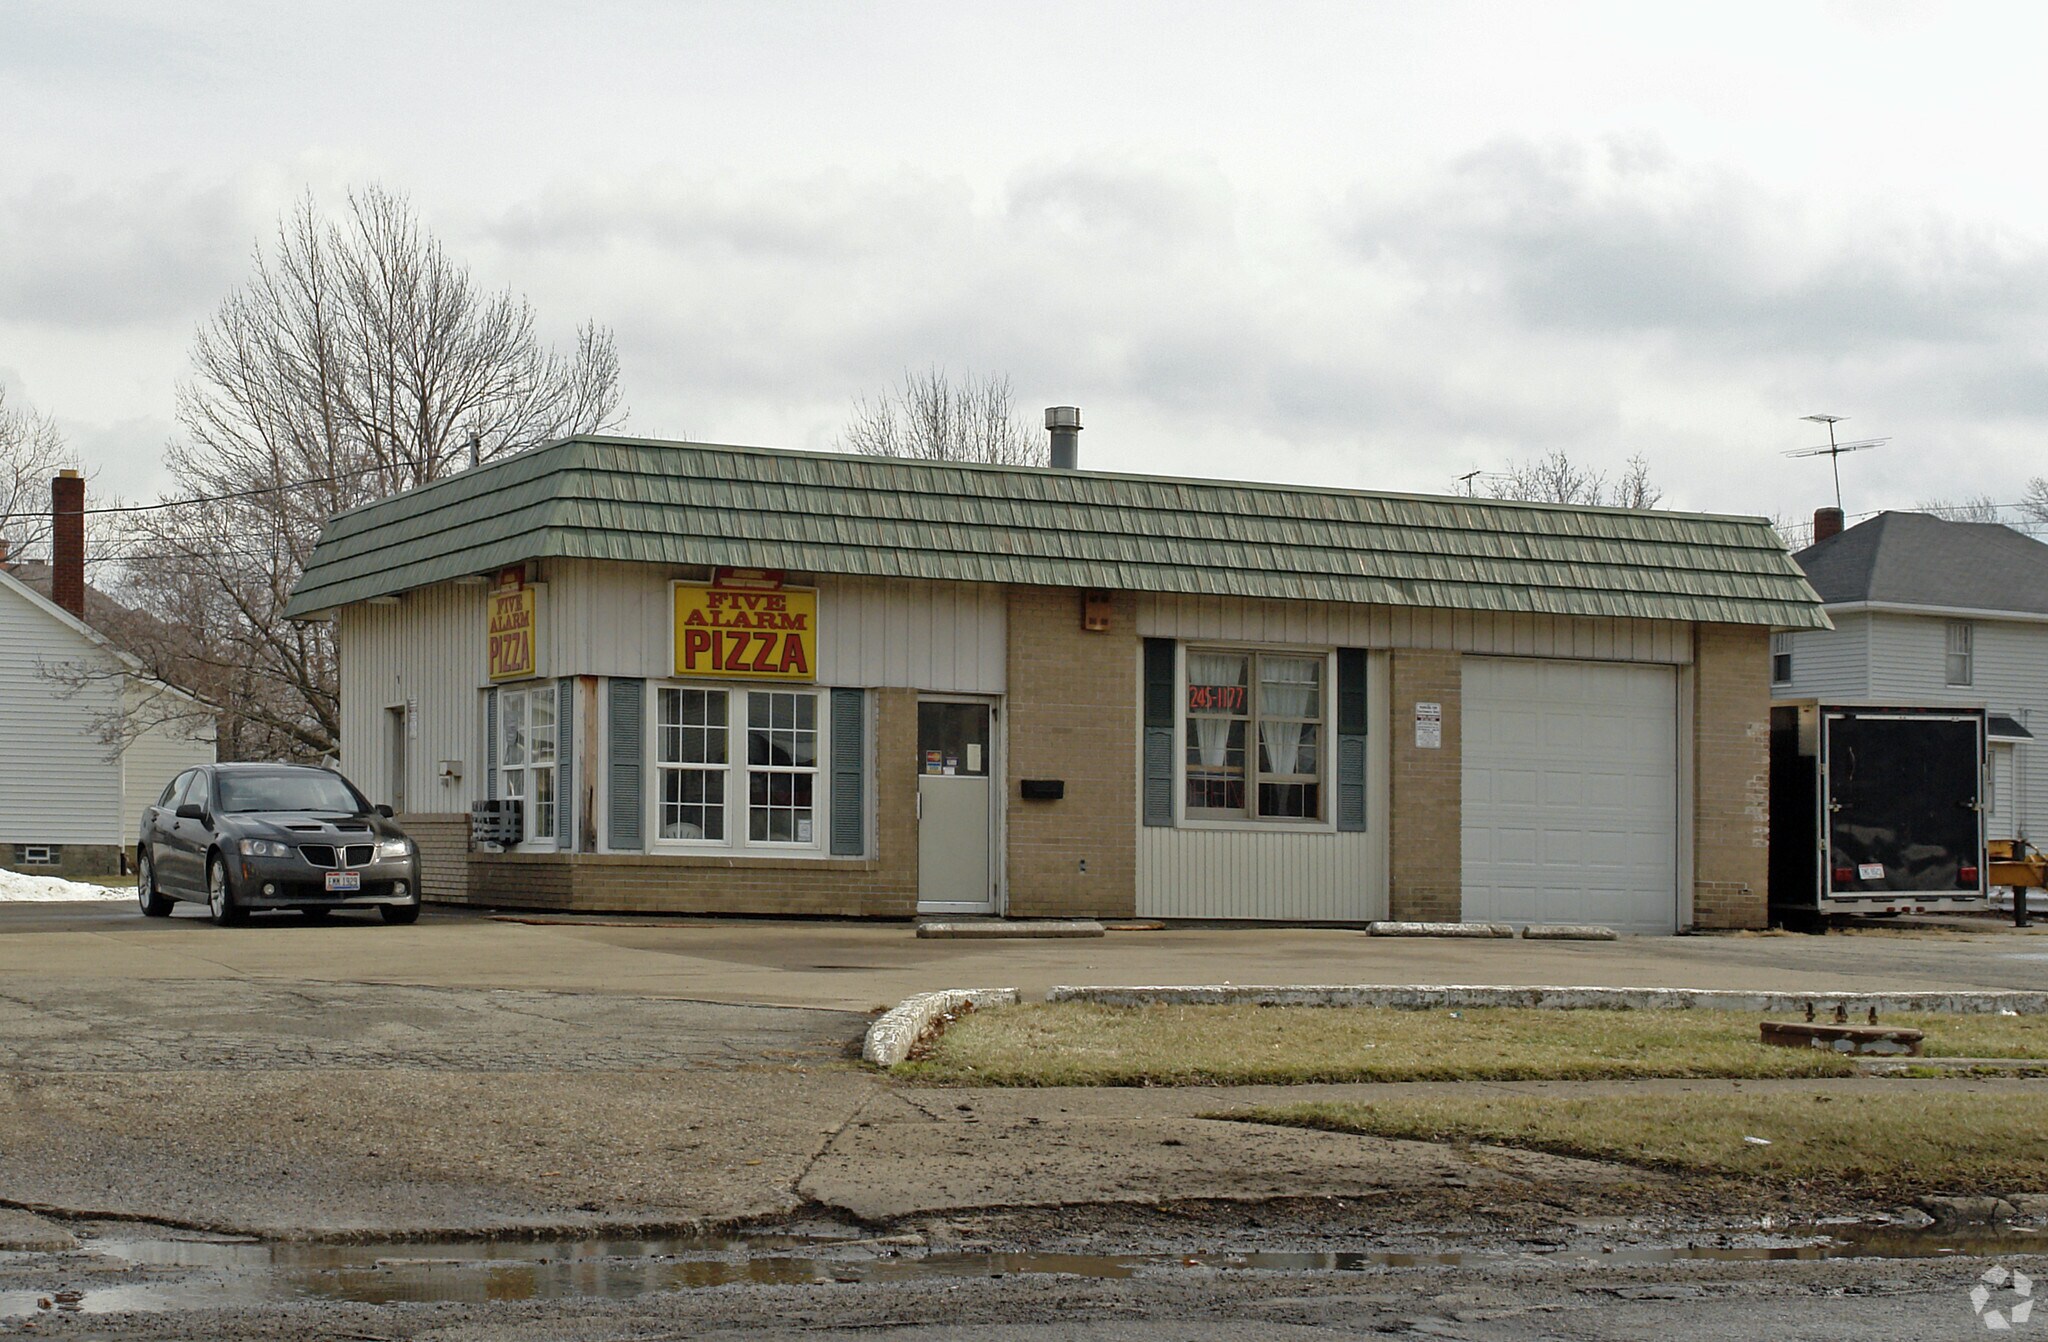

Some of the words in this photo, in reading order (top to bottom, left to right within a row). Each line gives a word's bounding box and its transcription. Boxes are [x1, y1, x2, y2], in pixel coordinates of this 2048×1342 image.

[496, 594, 523, 616] FIVE
[706, 591, 786, 611] FIVE
[490, 610, 530, 634] ALARM
[684, 608, 807, 630] ALARM
[489, 631, 530, 675] PIZZA
[685, 629, 808, 673] PIZZA
[1189, 686, 1243, 709] 245-1177
